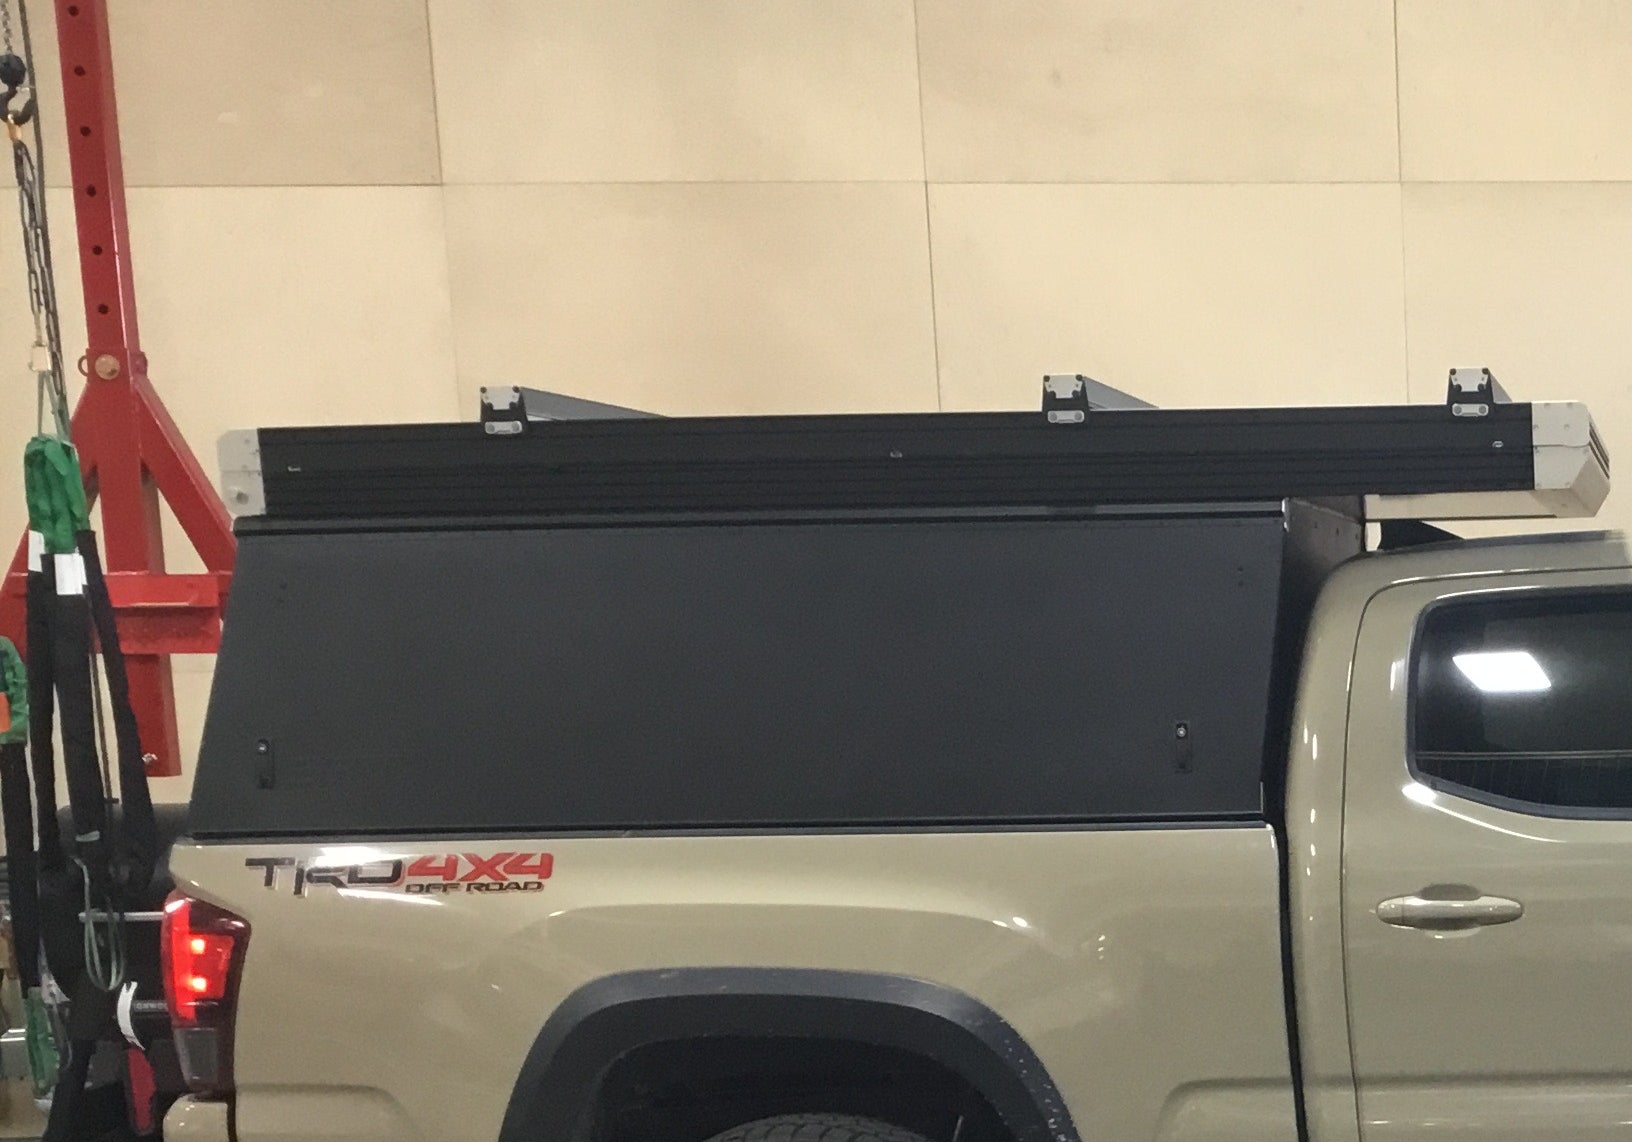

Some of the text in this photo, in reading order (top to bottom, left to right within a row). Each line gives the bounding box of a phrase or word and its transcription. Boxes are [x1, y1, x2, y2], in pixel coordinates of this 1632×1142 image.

[245, 857, 403, 897] TRD
[405, 881, 545, 896] OFF ROAD
